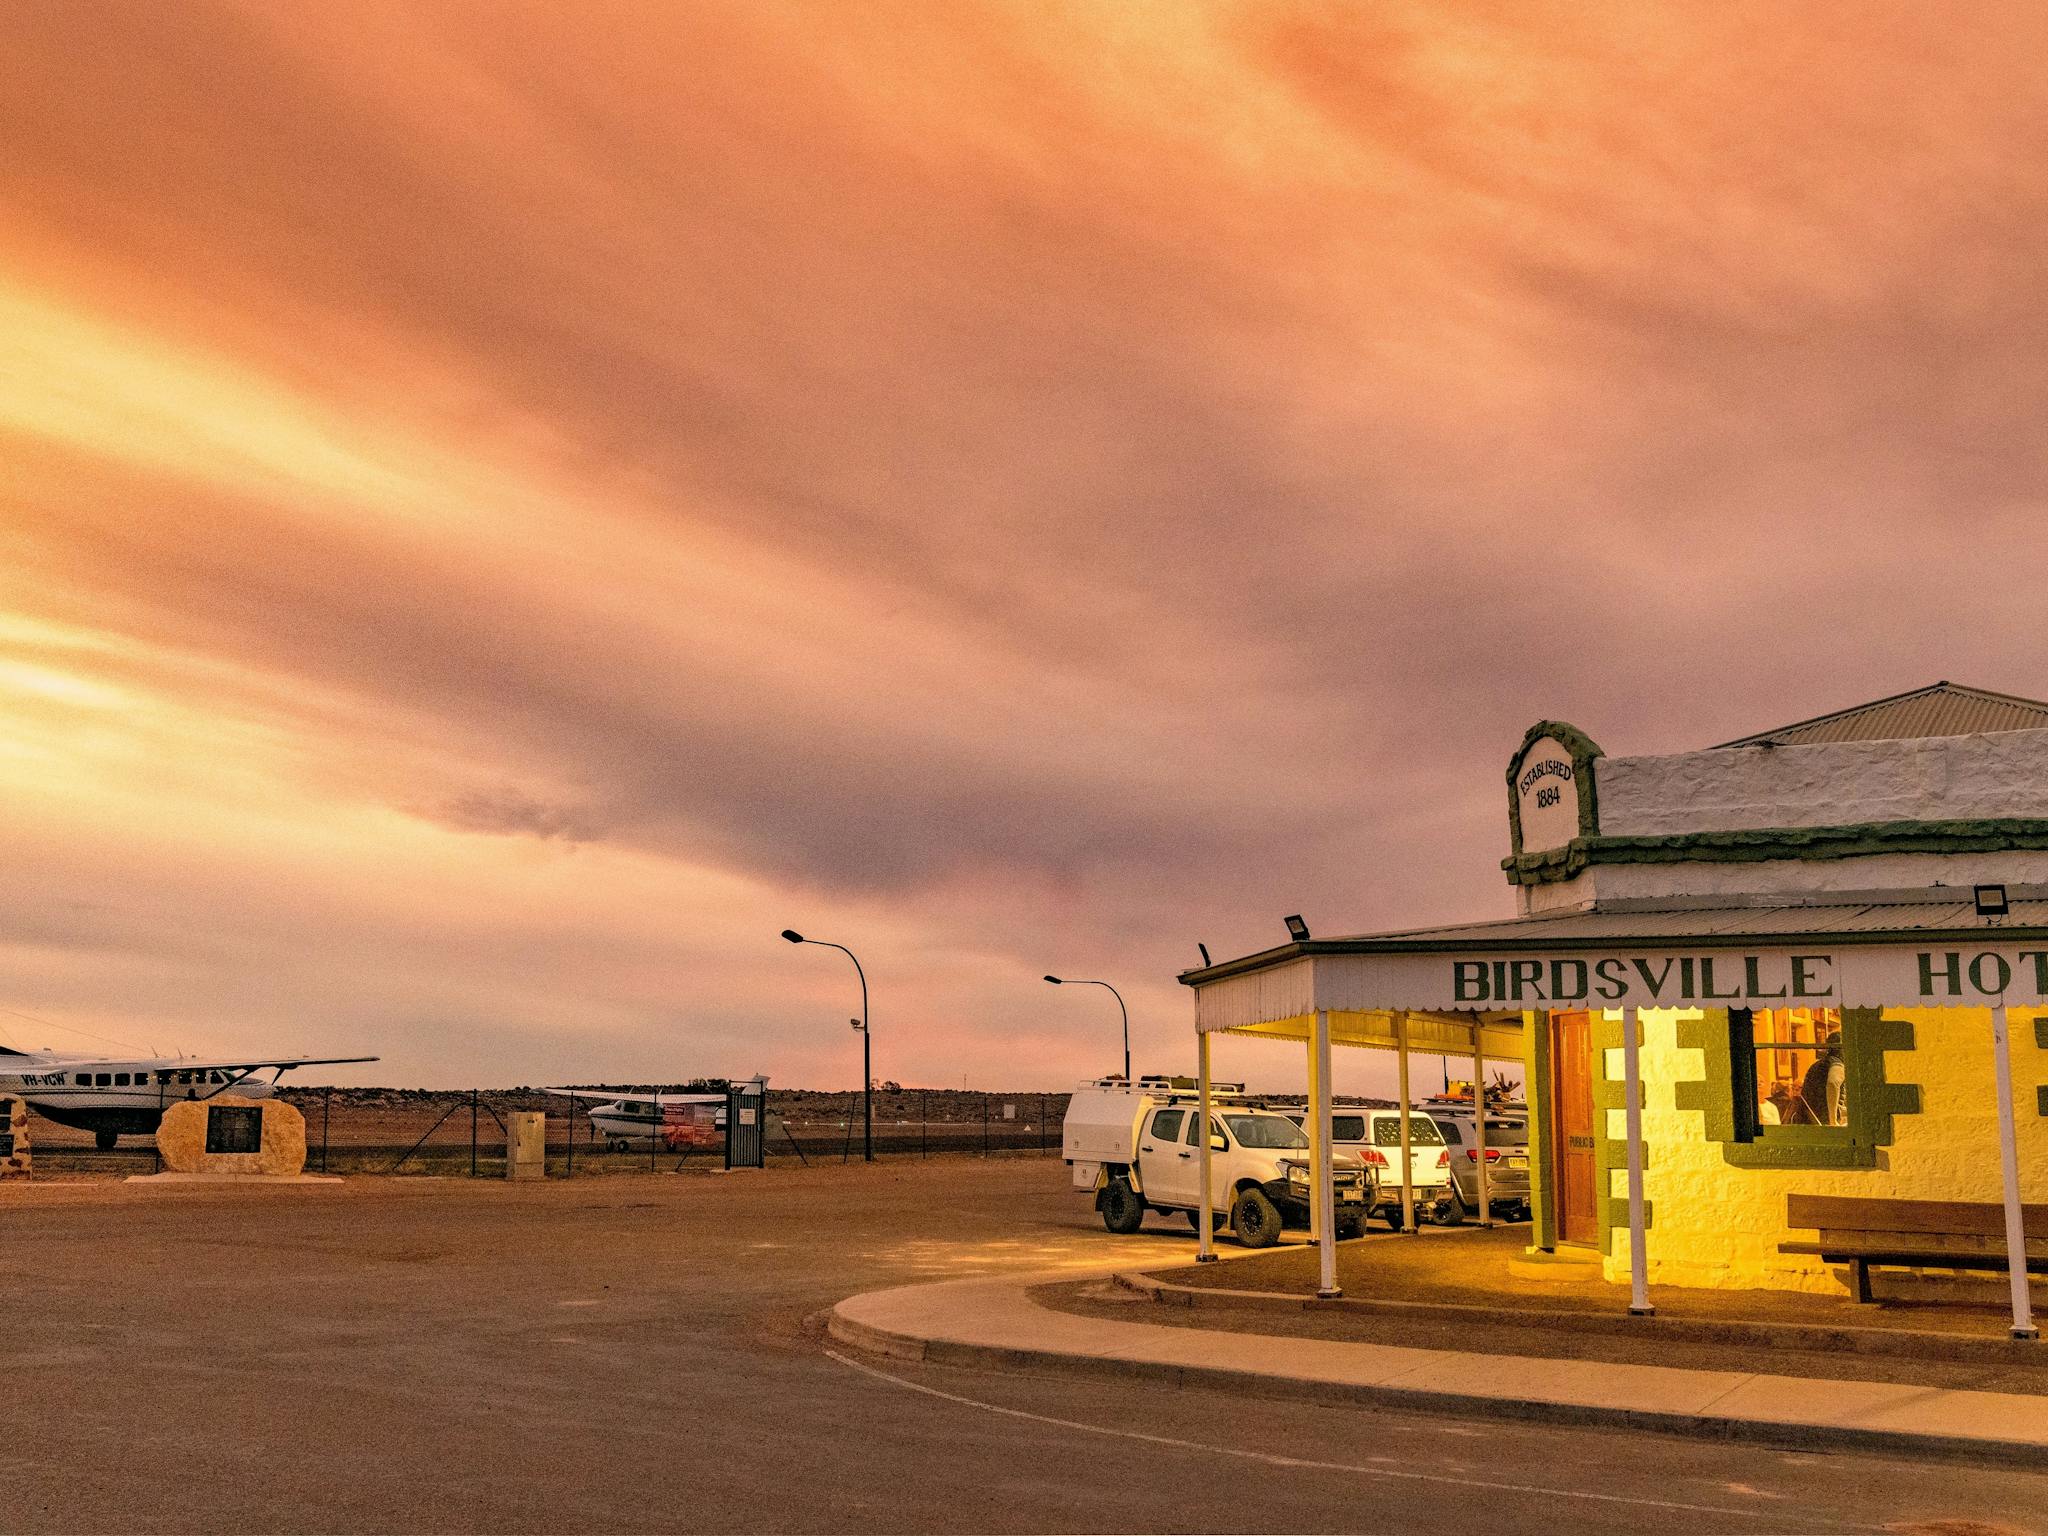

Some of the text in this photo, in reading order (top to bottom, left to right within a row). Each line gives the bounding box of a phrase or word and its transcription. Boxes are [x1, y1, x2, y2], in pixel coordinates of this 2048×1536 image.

[1520, 760, 1572, 797] ESTABLISHED
[1536, 786, 1560, 808] 1884
[1453, 955, 1833, 1001] BIRDSVILLE
